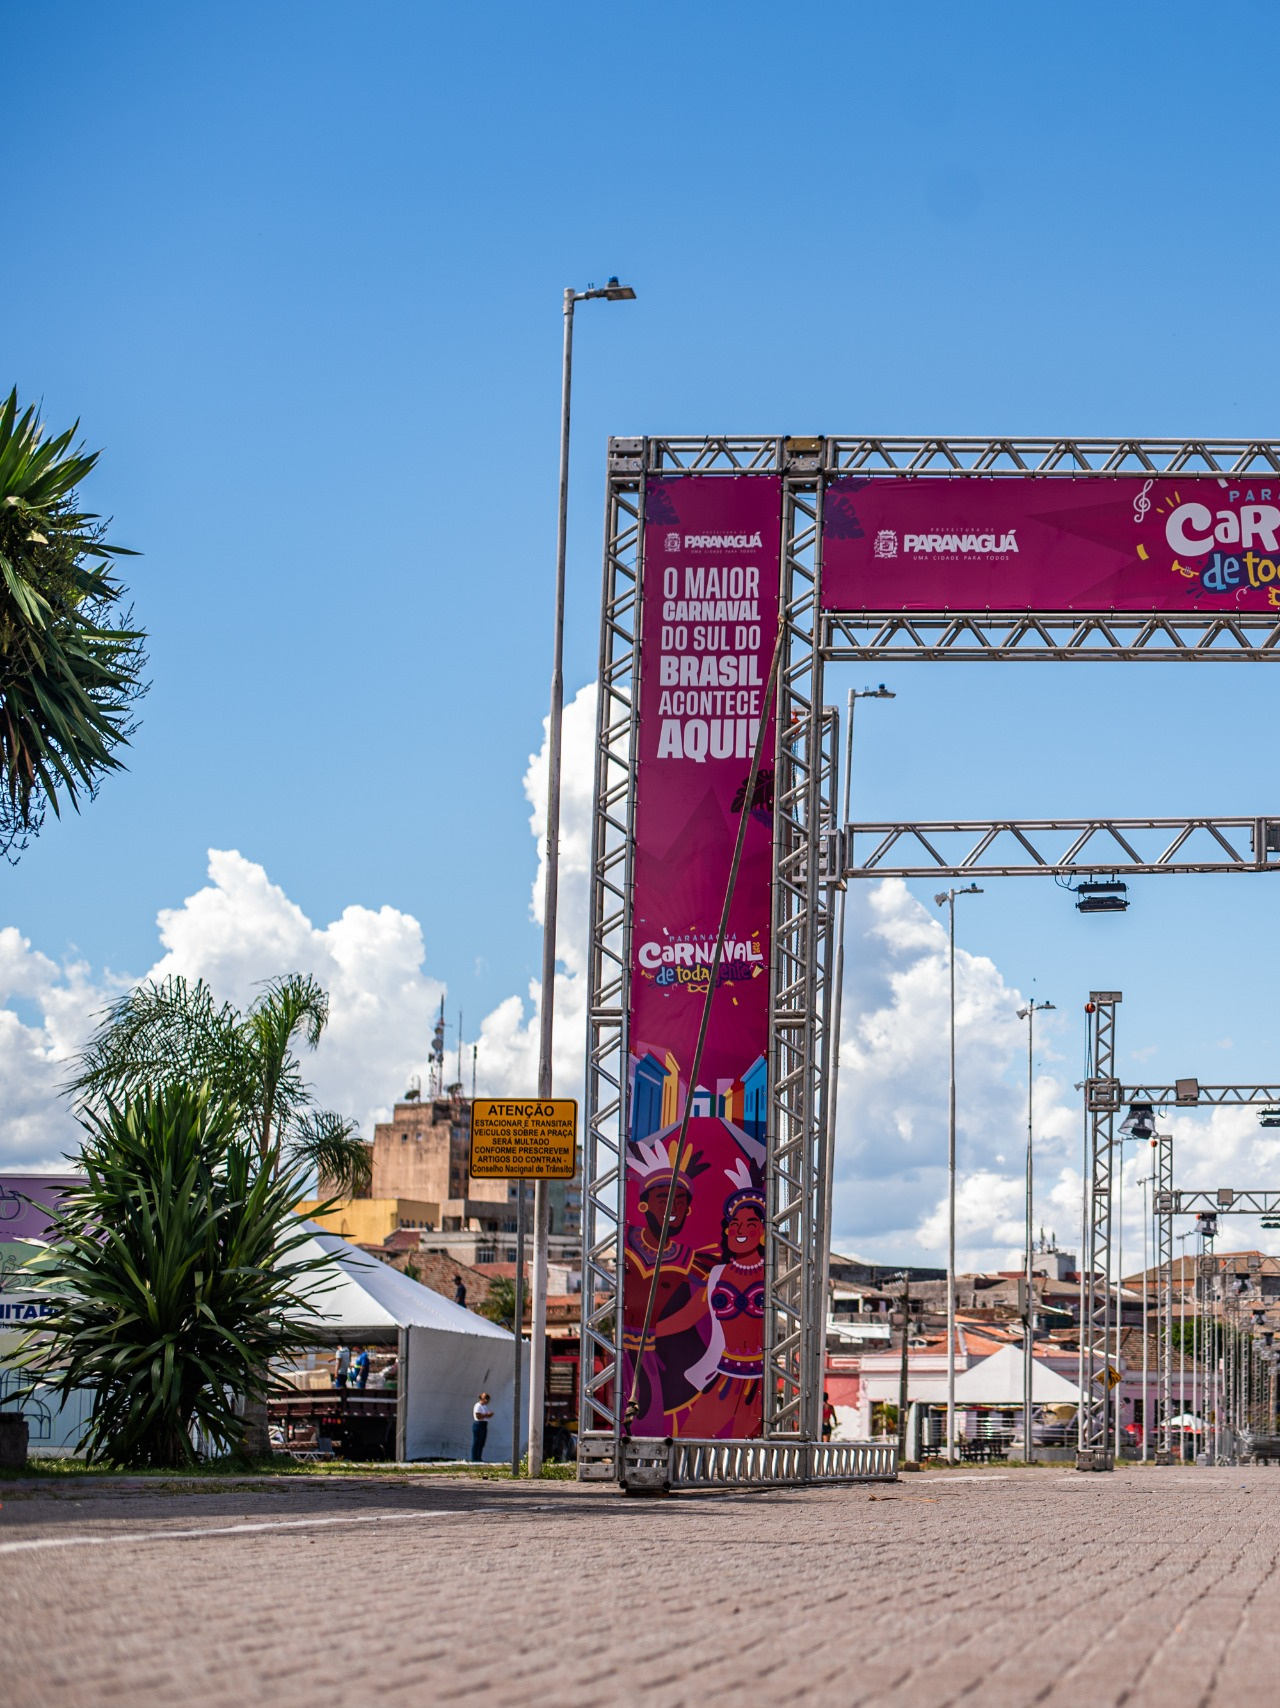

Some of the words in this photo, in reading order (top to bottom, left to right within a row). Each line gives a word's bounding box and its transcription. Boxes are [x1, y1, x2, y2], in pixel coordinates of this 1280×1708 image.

[684, 531, 763, 548] PARANAGUÁ
[903, 529, 1020, 553] PARANAGUÁ
[1204, 553, 1240, 591] de
[663, 566, 678, 599] O
[684, 566, 760, 599] MAIOR
[662, 600, 762, 621] CARNAVAL
[661, 625, 688, 651] DO
[693, 625, 731, 651] SUL
[734, 625, 761, 651] DO
[660, 655, 763, 687] BRASIL
[658, 690, 760, 716] ACONTECE
[657, 718, 761, 763] AQUI!
[656, 966, 675, 985] de
[487, 1103, 555, 1119] ATENÇÃO
[475, 1119, 522, 1127] ESTACIONAR
[523, 1119, 529, 1127] E
[531, 1119, 573, 1128] TRANSITAR
[512, 1128, 539, 1136] SOBRE
[547, 1129, 573, 1138] PRAÇA
[474, 1146, 517, 1154] CONFORME
[518, 1146, 570, 1155] PRESCREVEM
[492, 1137, 513, 1145] SERÁ
[514, 1138, 550, 1146] MULTADO
[472, 1164, 504, 1173] Conselho
[535, 1165, 544, 1173] de
[546, 1164, 573, 1174] Trânsito
[477, 1155, 511, 1163] ARTIGOS
[512, 1155, 524, 1163] DO
[525, 1156, 562, 1164] CONTRAN
